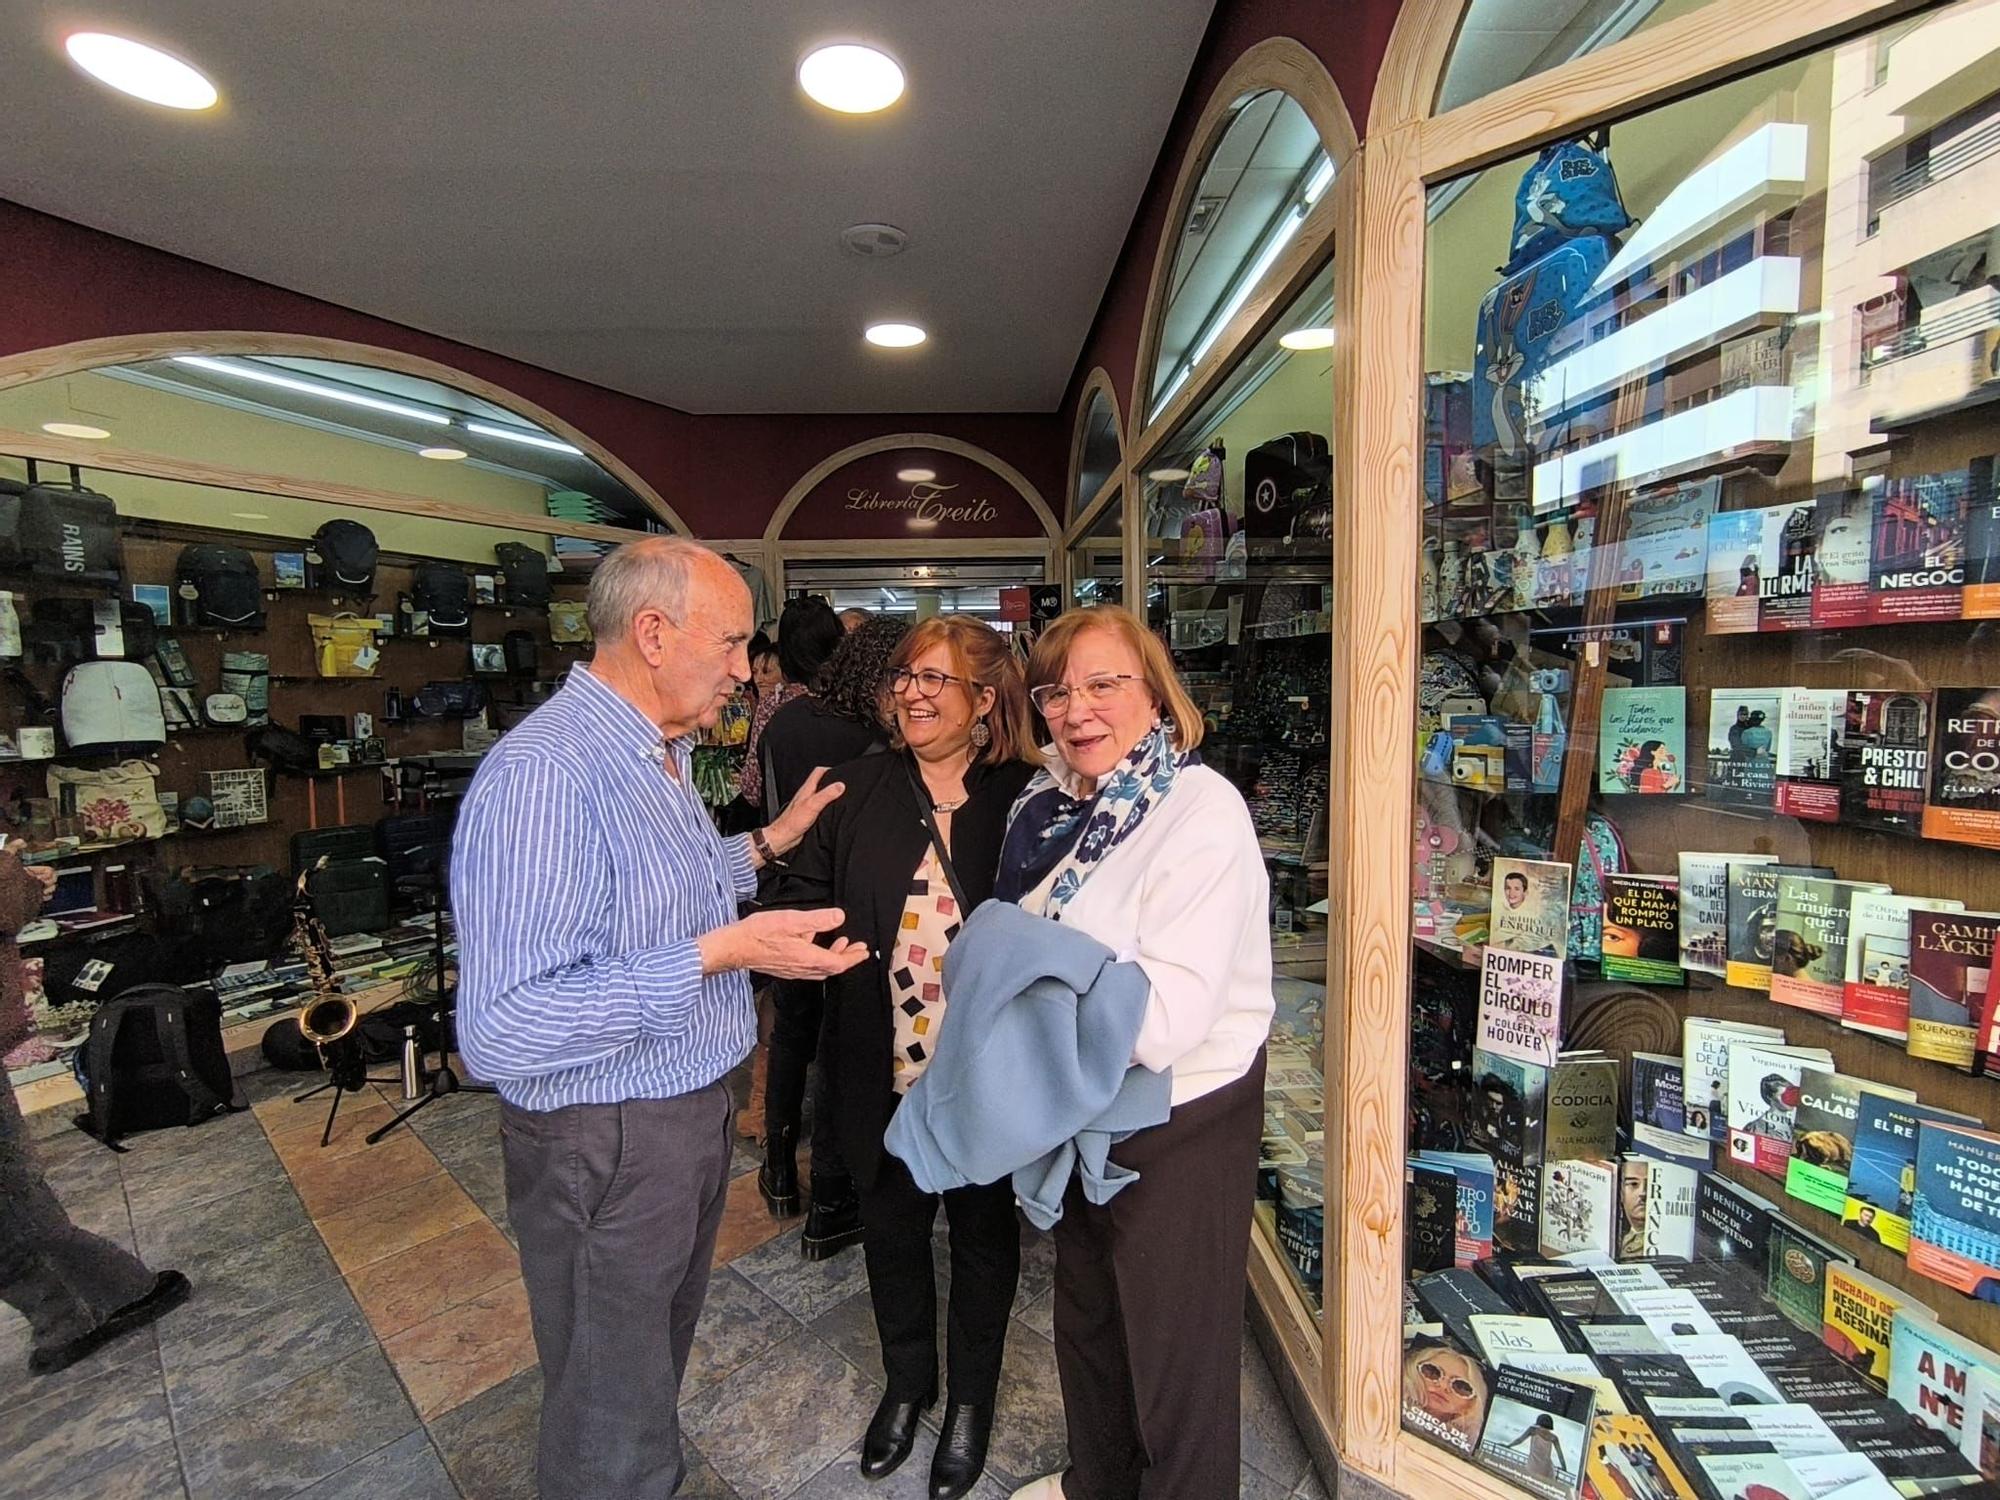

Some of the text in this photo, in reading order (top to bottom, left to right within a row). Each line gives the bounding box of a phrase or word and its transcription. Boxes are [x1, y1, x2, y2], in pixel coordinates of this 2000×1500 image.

[911, 481, 999, 523] Treito
[61, 523, 86, 574] RAINS
[1794, 555, 1813, 576] LA
[1924, 555, 1945, 569] EL
[1628, 703, 1656, 715] Todas
[1798, 701, 1843, 712] niños de
[1609, 713, 1675, 727] las flores que
[1785, 711, 1824, 721] altamar
[1976, 738, 1995, 748] DE
[1861, 747, 1927, 770] PRESTO
[1731, 769, 1769, 779] La casa
[1863, 768, 1879, 786] &
[1740, 778, 1775, 789] Rivier
[1943, 784, 1984, 795] CLARA
[1612, 879, 1664, 890] NICOLÁS MUÑOZ
[1709, 874, 1726, 885] LOS
[1627, 887, 1664, 900] EL DÍA
[1788, 887, 1819, 902] Las
[1613, 896, 1679, 911] QUE MAMÁ
[1710, 900, 1725, 911] DEL
[1621, 906, 1669, 920] ROMPIÓ
[1499, 918, 1556, 938] ENRIQUE
[1615, 916, 1674, 930] UN PLATO
[1804, 915, 1836, 930] que
[1486, 952, 1554, 981] ROMPER
[1485, 971, 1503, 990] EL
[1483, 988, 1553, 1018] CÍRCULO
[1494, 1017, 1536, 1035] COLLEEN
[1915, 1022, 1966, 1039] SUEÑOS
[1486, 1026, 1542, 1051] HOOVER
[1702, 1041, 1717, 1054] EL
[1695, 1051, 1715, 1065] DE
[1664, 1072, 1681, 1082] Liz
[1551, 1094, 1614, 1107] CODICIA
[1801, 1094, 1858, 1120] CALAB
[1873, 1117, 1890, 1132] EL
[1888, 1112, 1916, 1125] PABLO
[1555, 1135, 1575, 1145] ANA
[1948, 1140, 1985, 1157] MANU
[1935, 1163, 1964, 1179] MIS
[1517, 1187, 1537, 1200] DEL
[1712, 1190, 1754, 1224] BENÍTEZ
[1961, 1196, 1984, 1213] DE
[1711, 1206, 1742, 1233] LUZ DE
[1701, 1209, 1754, 1250] TUNGSTENO
[1832, 1274, 1877, 1307] RICHARD
[1489, 1330, 1533, 1348] Alas
[1639, 1368, 1649, 1377] de
[1650, 1368, 1659, 1377] la
[1499, 1374, 1551, 1396] CON AGATHA
[1496, 1382, 1552, 1404] EN ESTAMBUL
[1410, 1406, 1469, 1443] CHICA DE
[1707, 1460, 1743, 1473] Santiago
